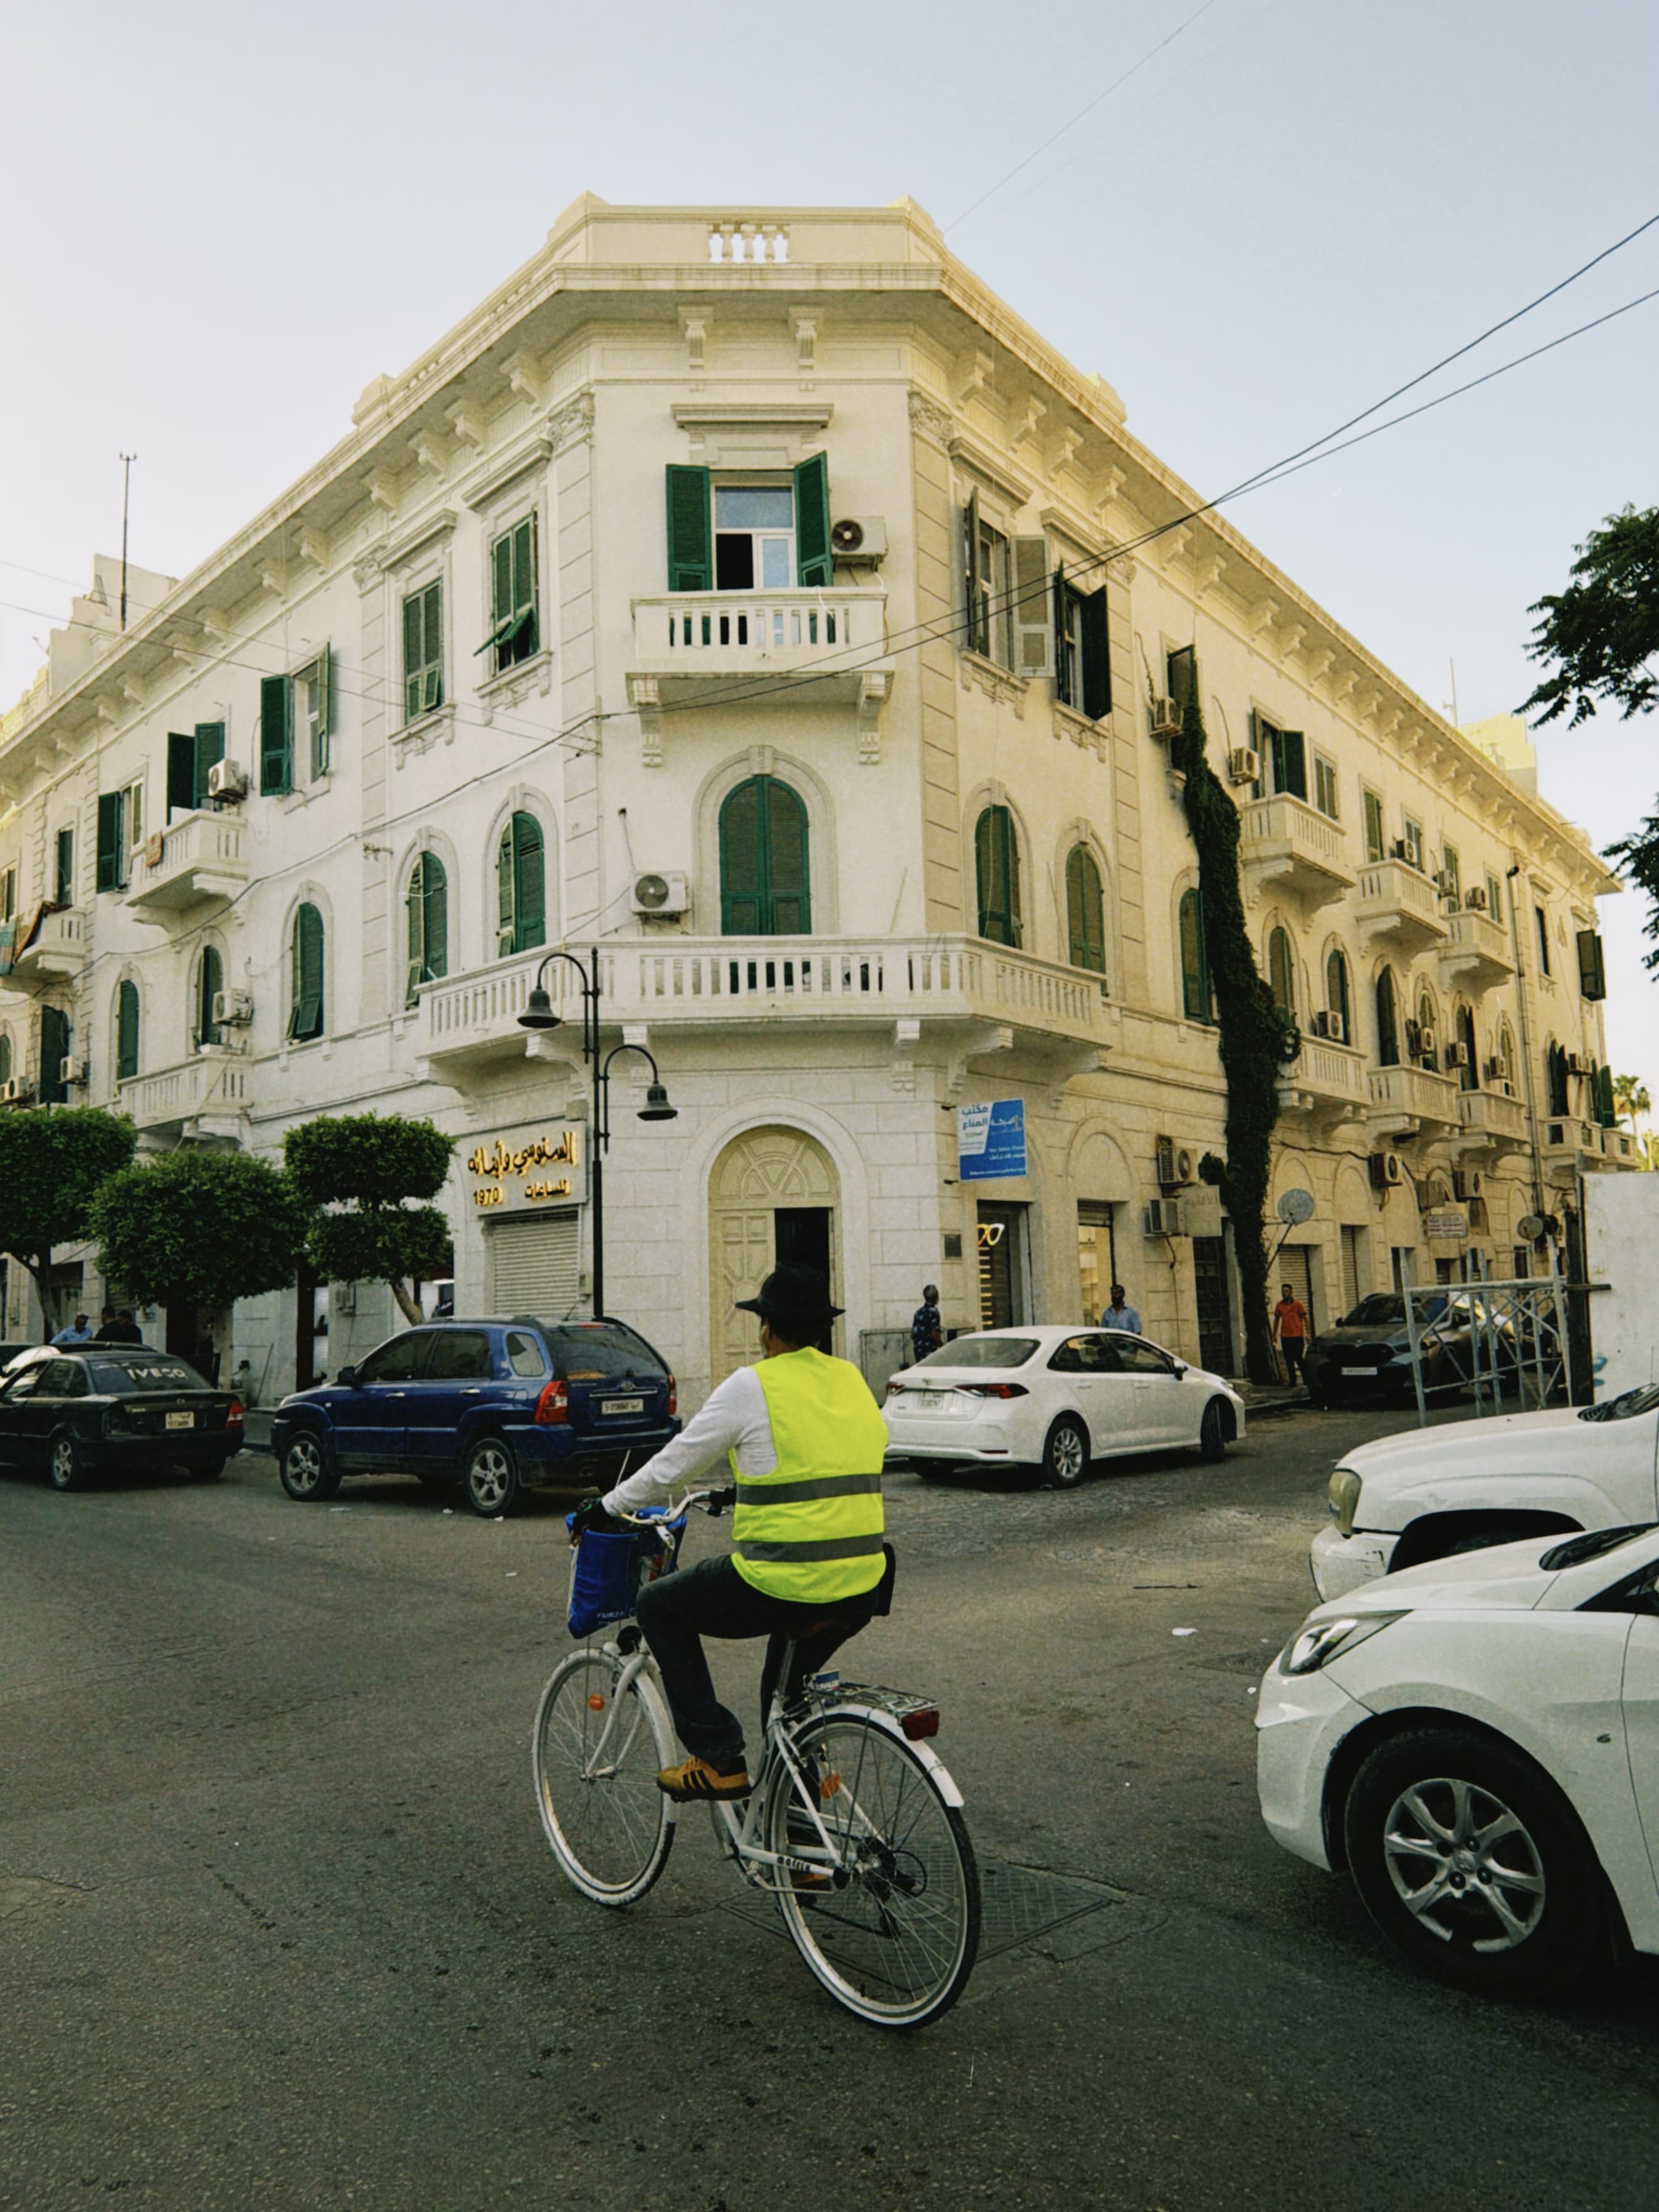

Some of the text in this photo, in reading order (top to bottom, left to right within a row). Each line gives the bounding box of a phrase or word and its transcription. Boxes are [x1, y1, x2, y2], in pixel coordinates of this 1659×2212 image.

[962, 1104, 988, 1118] مكتب
[513, 1131, 578, 1178] السنوسي
[473, 1186, 504, 1205] 1970
